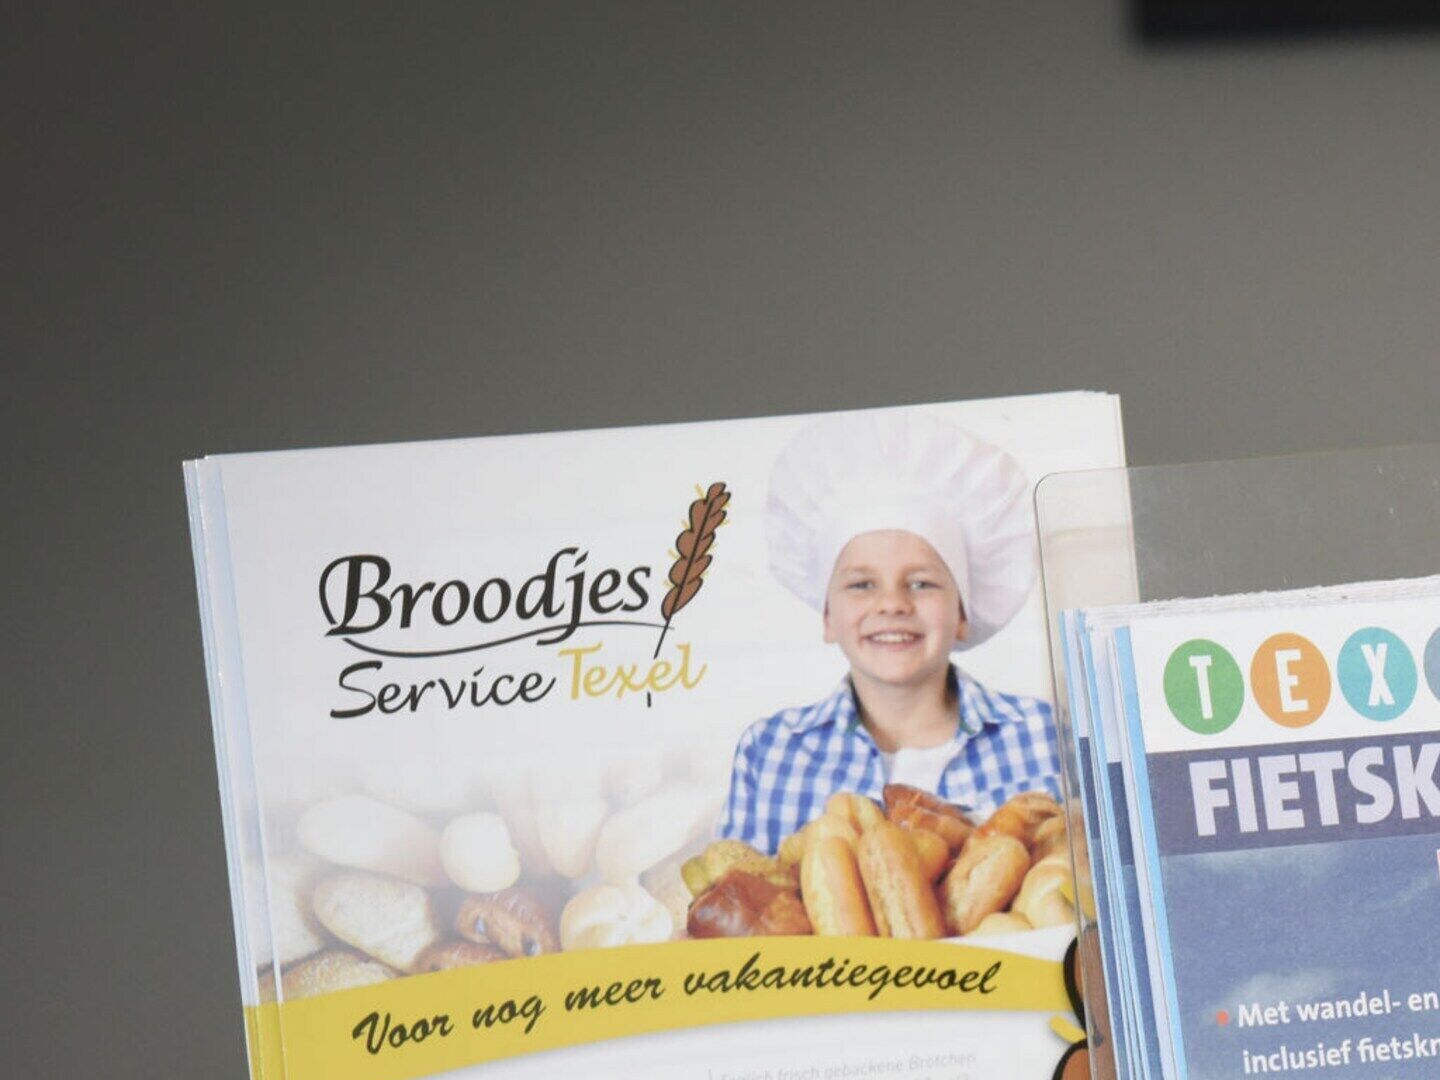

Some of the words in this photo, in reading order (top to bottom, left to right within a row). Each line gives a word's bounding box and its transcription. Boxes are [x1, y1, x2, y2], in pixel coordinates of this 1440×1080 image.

[319, 547, 651, 645] Broodjes
[330, 659, 556, 719] Service
[558, 642, 708, 700] Texel
[351, 1010, 454, 1055] Voor
[471, 995, 546, 1034] nog
[564, 977, 664, 1011] meer
[683, 952, 1002, 1000] vakantiegevoel
[1237, 1003, 1290, 1027] Met
[1295, 988, 1401, 1021] wandel-
[1406, 991, 1439, 1011] en
[1242, 1038, 1351, 1074] inclusief
